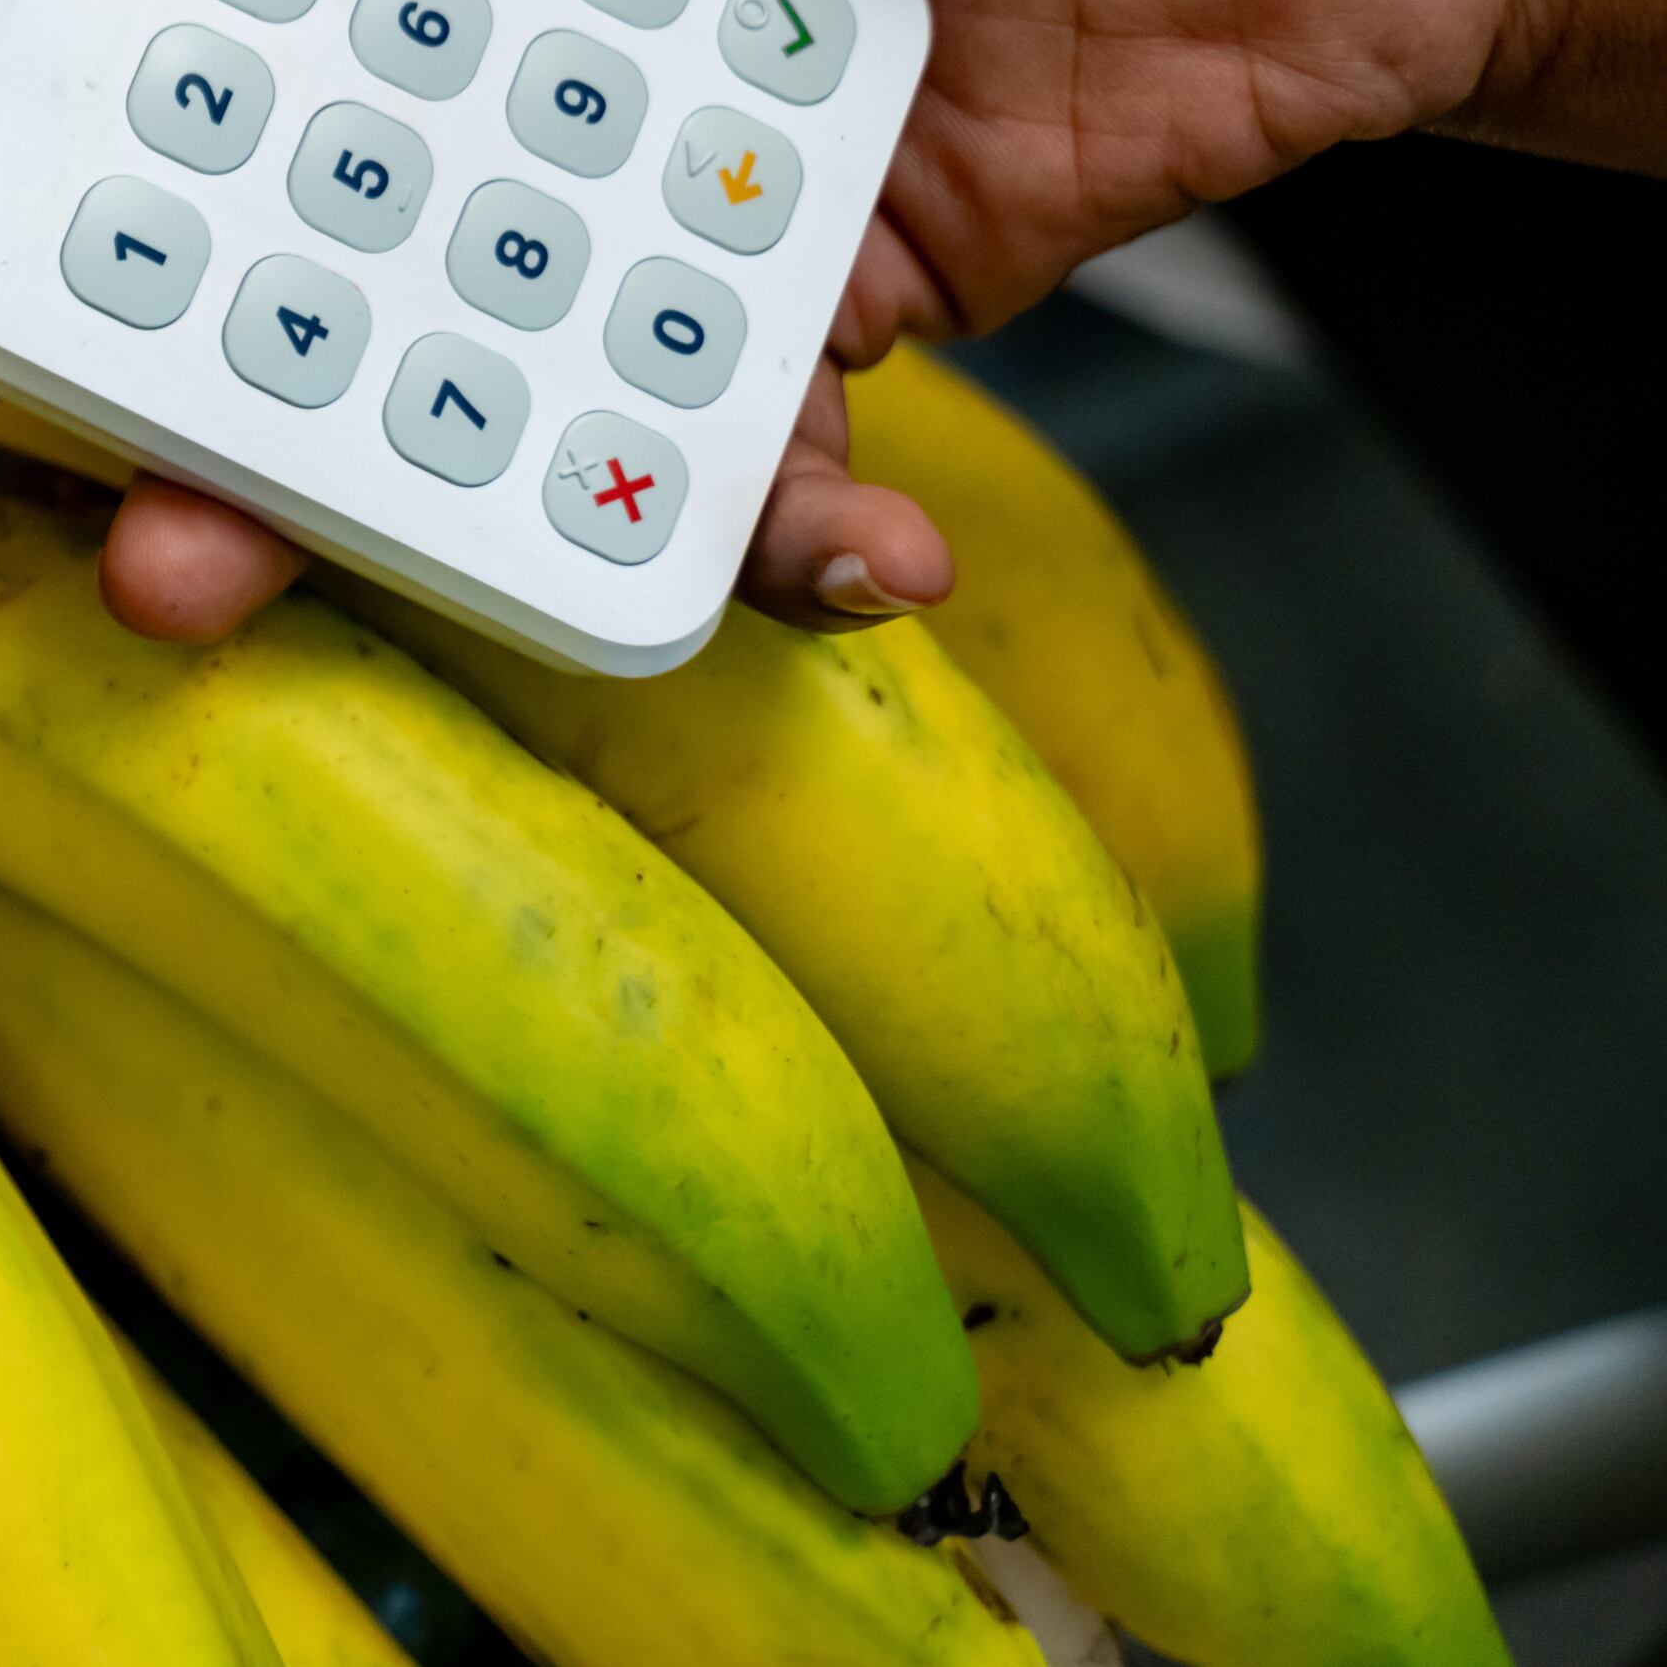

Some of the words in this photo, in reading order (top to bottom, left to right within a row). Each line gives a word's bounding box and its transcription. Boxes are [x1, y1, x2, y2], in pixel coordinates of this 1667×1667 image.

[397, 0, 451, 49] 6
[174, 72, 234, 126] 2
[553, 78, 607, 126] 9
[332, 149, 391, 201] 5
[113, 230, 169, 266] 1
[494, 228, 550, 280] 8
[275, 304, 330, 358] 4
[651, 308, 707, 356] 0
[429, 378, 488, 431] 7
